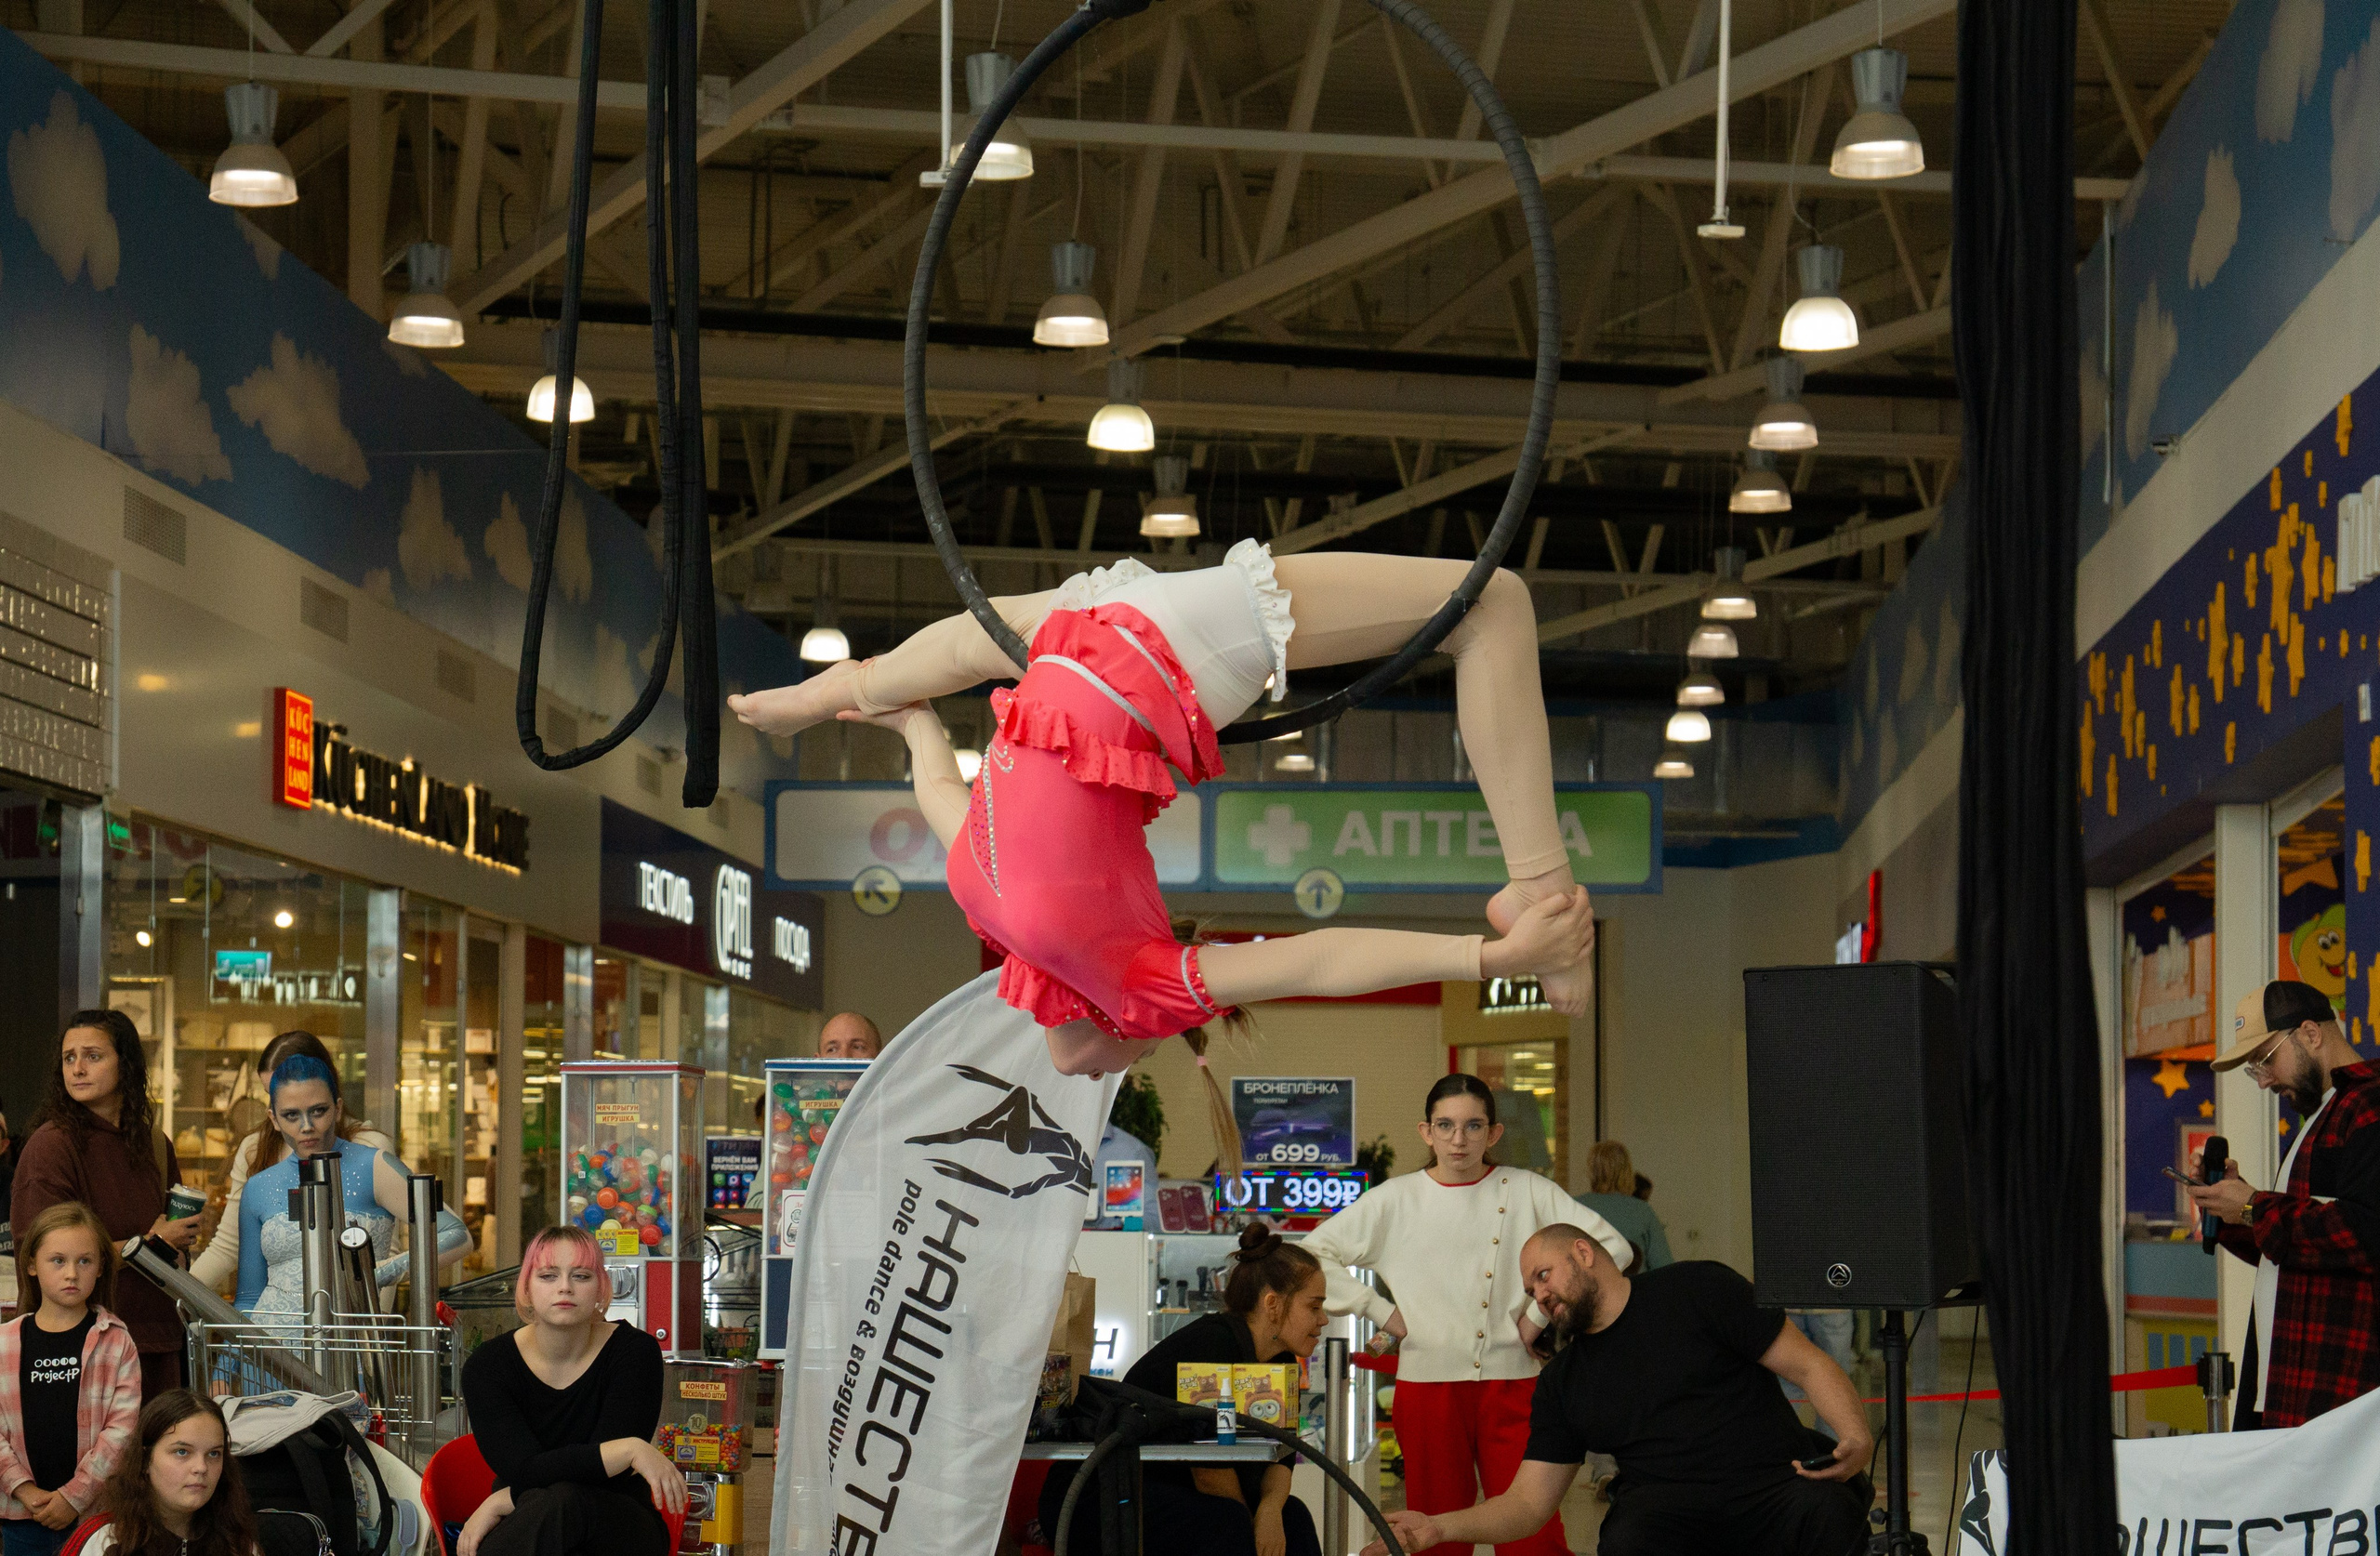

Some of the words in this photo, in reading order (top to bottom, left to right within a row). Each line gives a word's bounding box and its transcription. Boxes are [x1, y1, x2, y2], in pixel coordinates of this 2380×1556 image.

[1333, 810, 1593, 857] АПТЕА
[640, 861, 694, 925] ТЕКСТИЛЬ
[1243, 1080, 1339, 1094] БРОНЕПЛЁНКА
[1271, 1143, 1320, 1163] 699
[892, 1179, 922, 1235] pole
[1225, 1177, 1275, 1207] ОТ
[865, 1240, 903, 1315] dance
[2118, 1504, 2380, 1556] ШЕСТВ
